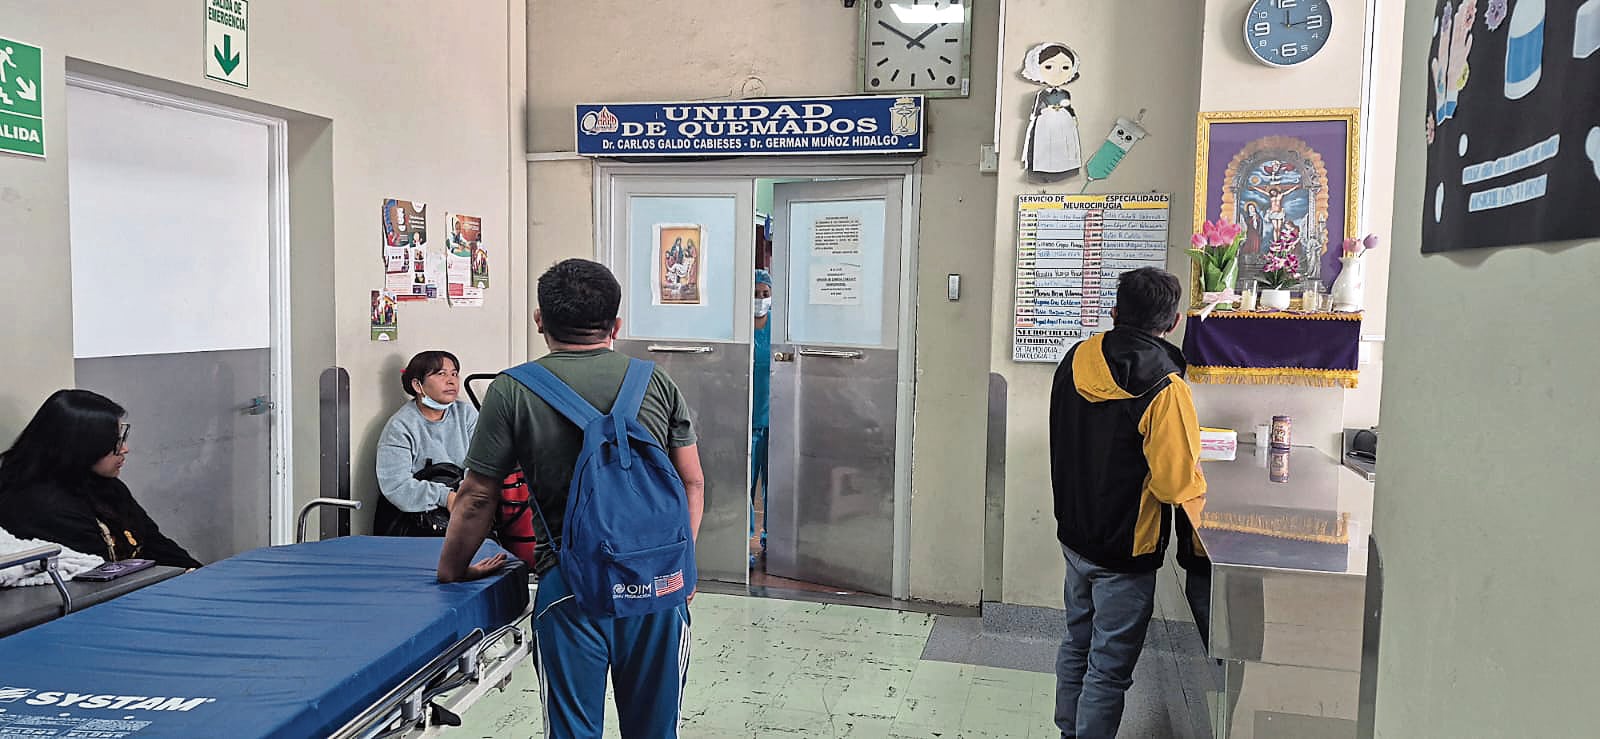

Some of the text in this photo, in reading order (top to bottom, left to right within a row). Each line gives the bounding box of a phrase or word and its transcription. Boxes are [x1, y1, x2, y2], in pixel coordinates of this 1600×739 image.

[234, 1, 242, 15] DE
[208, 7, 245, 31] EMERGENCIA
[1306, 14, 1322, 30] 3
[1254, 21, 1271, 37] 9
[1281, 42, 1298, 57] 6
[662, 103, 833, 121] UNIDAD
[621, 117, 878, 139] DE QUEMADOS
[602, 139, 615, 150] Dr.
[617, 139, 656, 150] CARLOS
[658, 138, 691, 149] GALDO
[693, 138, 742, 149] CABIESES
[750, 138, 763, 149] Dr.
[765, 136, 809, 148] GERMAN
[811, 134, 849, 148] MUÑOZ
[852, 135, 899, 147] HIDALGO
[1020, 194, 1169, 203] SERVICIO DE ESPECIALIDADES
[1063, 202, 1123, 210] NEUROCIRUGIA
[626, 583, 652, 594] OIM
[26, 692, 208, 711] SYSTAM
